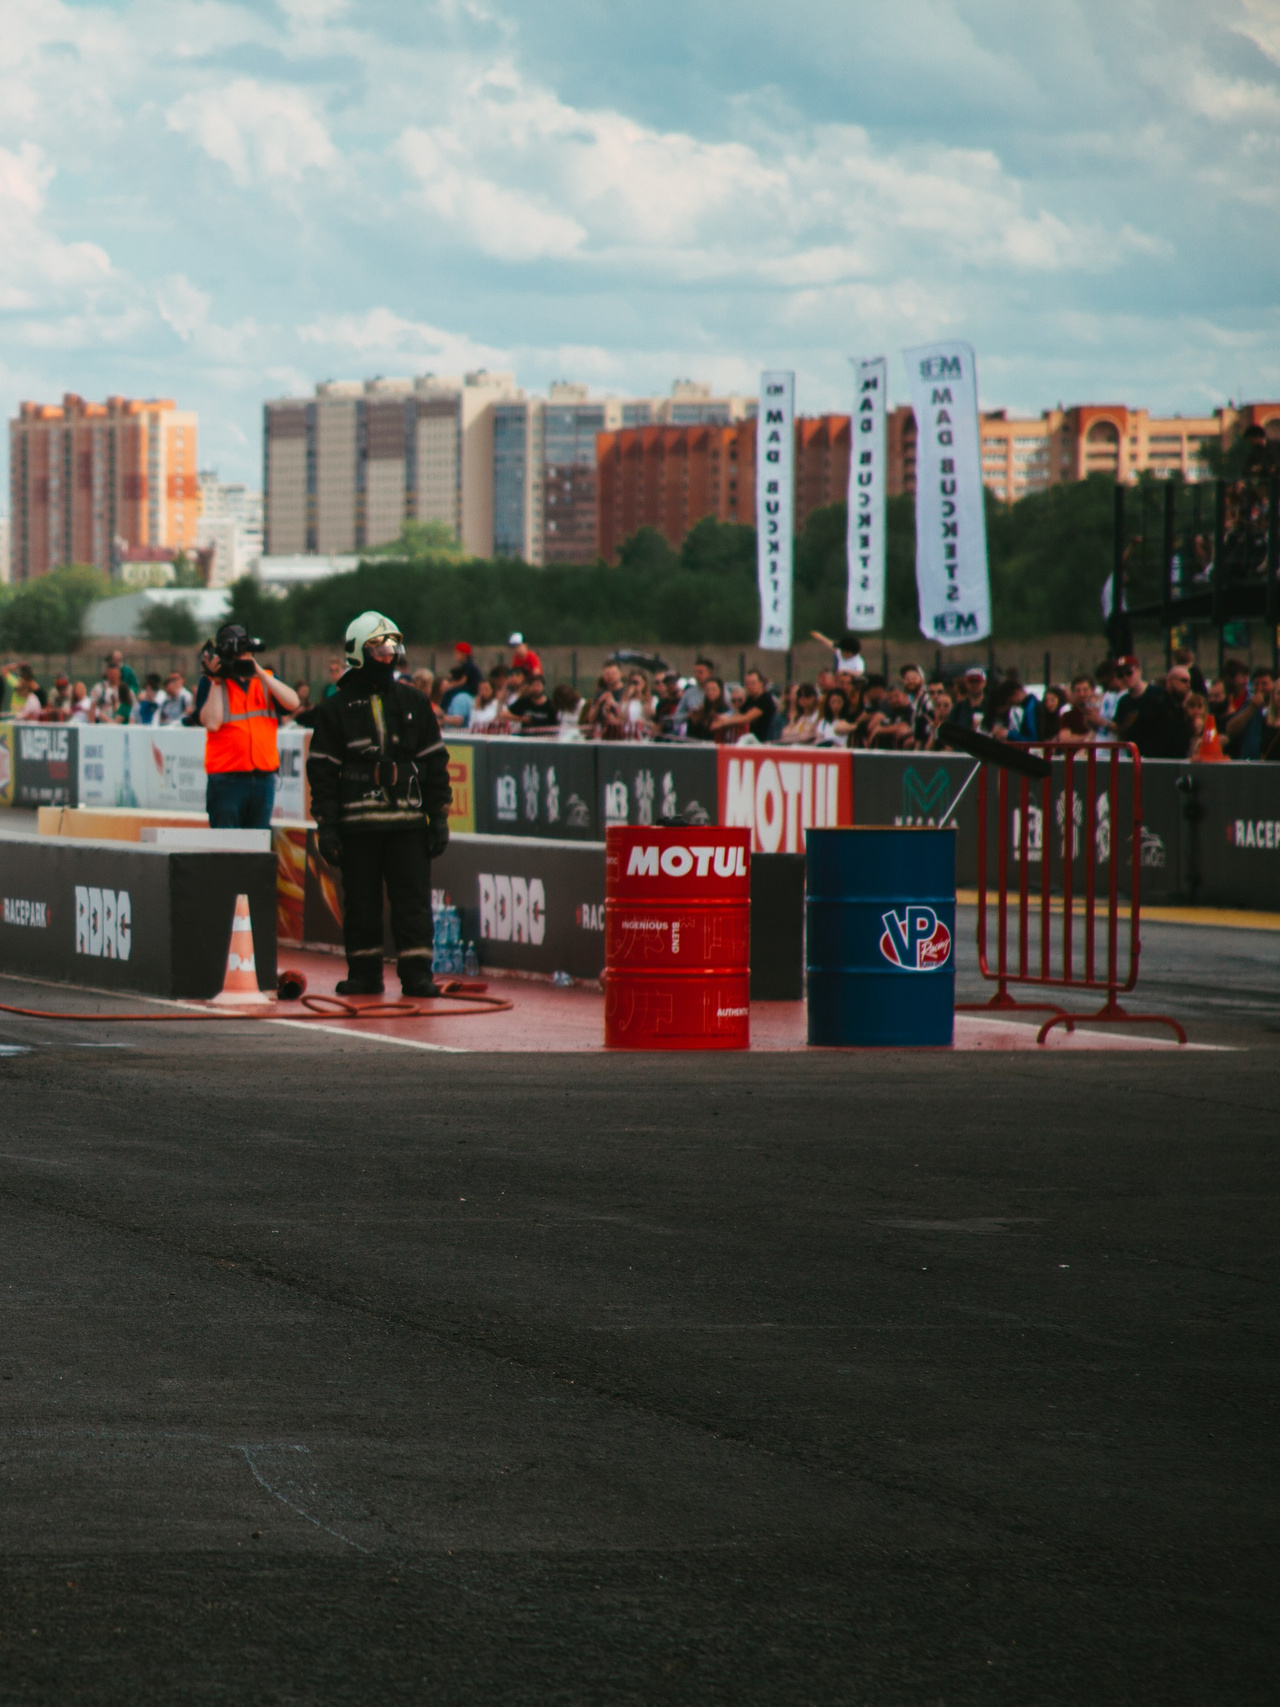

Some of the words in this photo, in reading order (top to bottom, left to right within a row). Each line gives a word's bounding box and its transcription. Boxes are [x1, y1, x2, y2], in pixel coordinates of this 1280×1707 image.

[627, 846, 747, 877] MOTUL
[4, 898, 47, 928] RACEPARK
[622, 921, 668, 930] INGENIOUS
[672, 922, 680, 954] BLEND
[881, 906, 937, 968] VP
